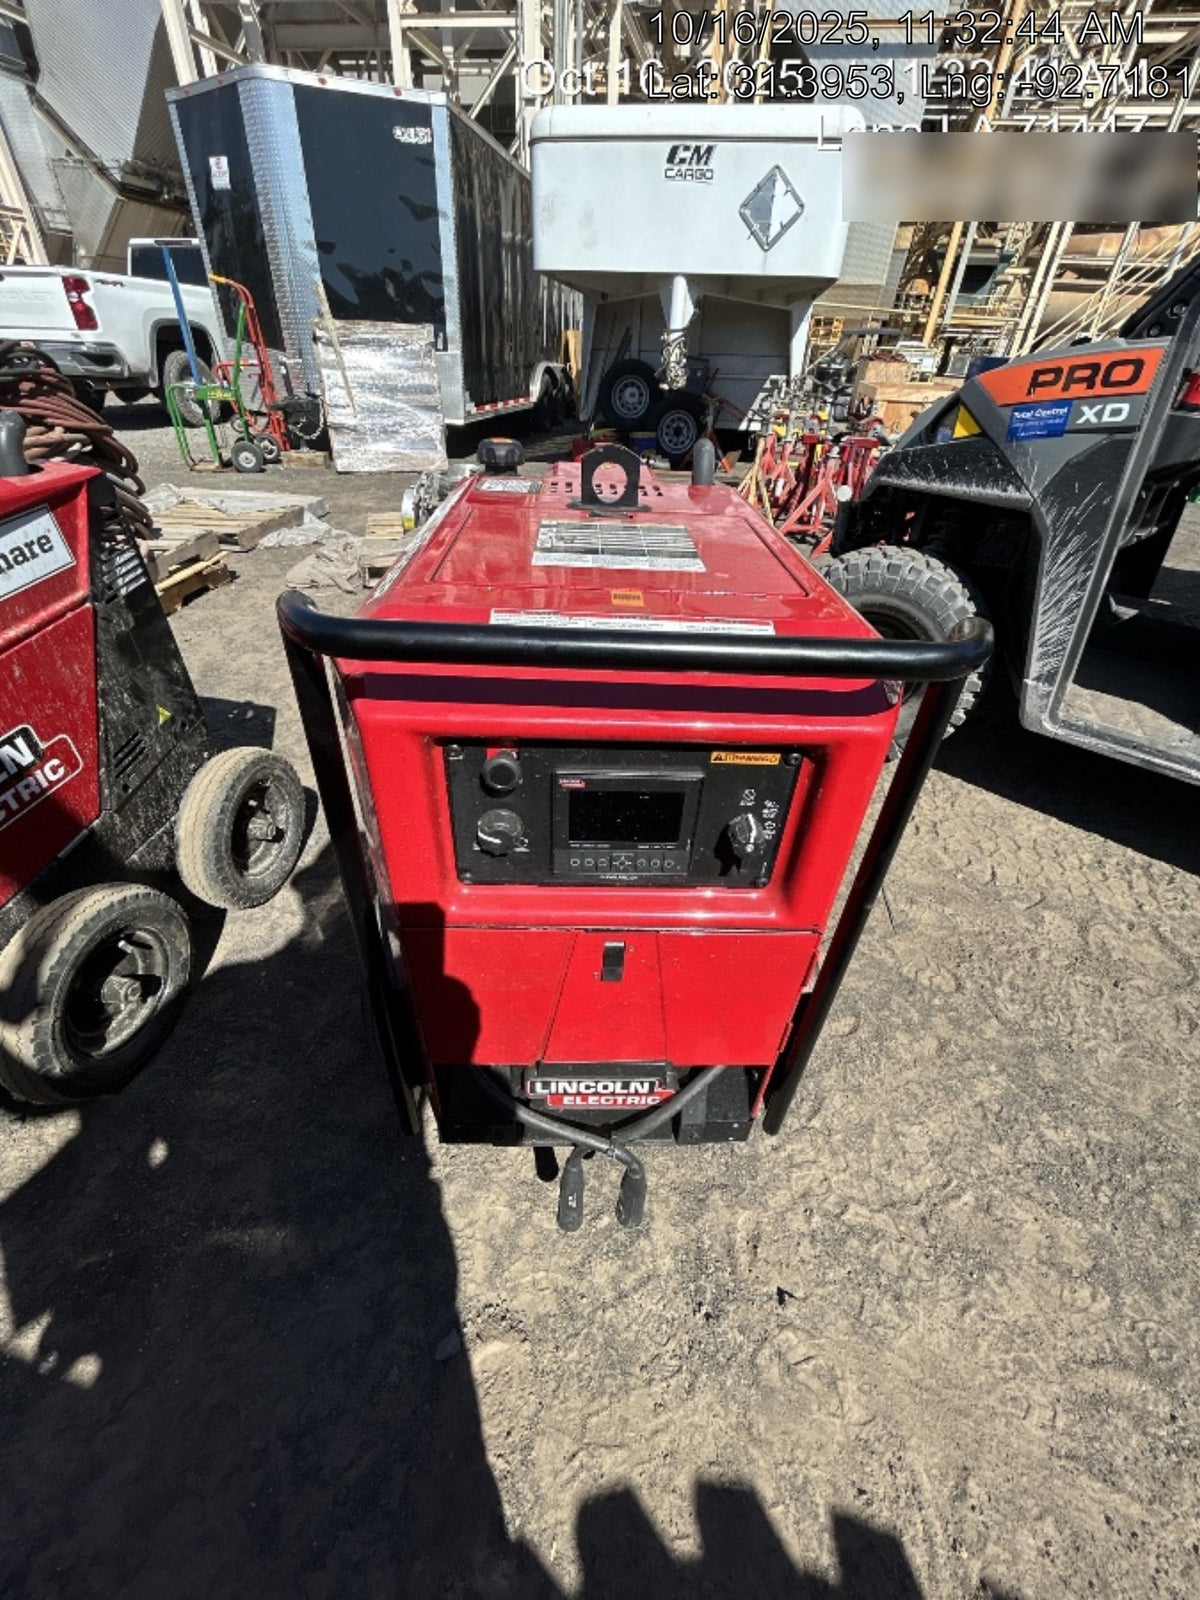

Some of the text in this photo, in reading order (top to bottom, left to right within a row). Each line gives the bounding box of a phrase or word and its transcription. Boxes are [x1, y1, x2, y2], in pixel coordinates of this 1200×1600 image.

[664, 168, 714, 181] CARGO
[1026, 358, 1145, 397] PRO
[1076, 402, 1130, 424] XD
[535, 1081, 650, 1094] LINCOLN
[562, 1095, 662, 1106] ELECTRIC
